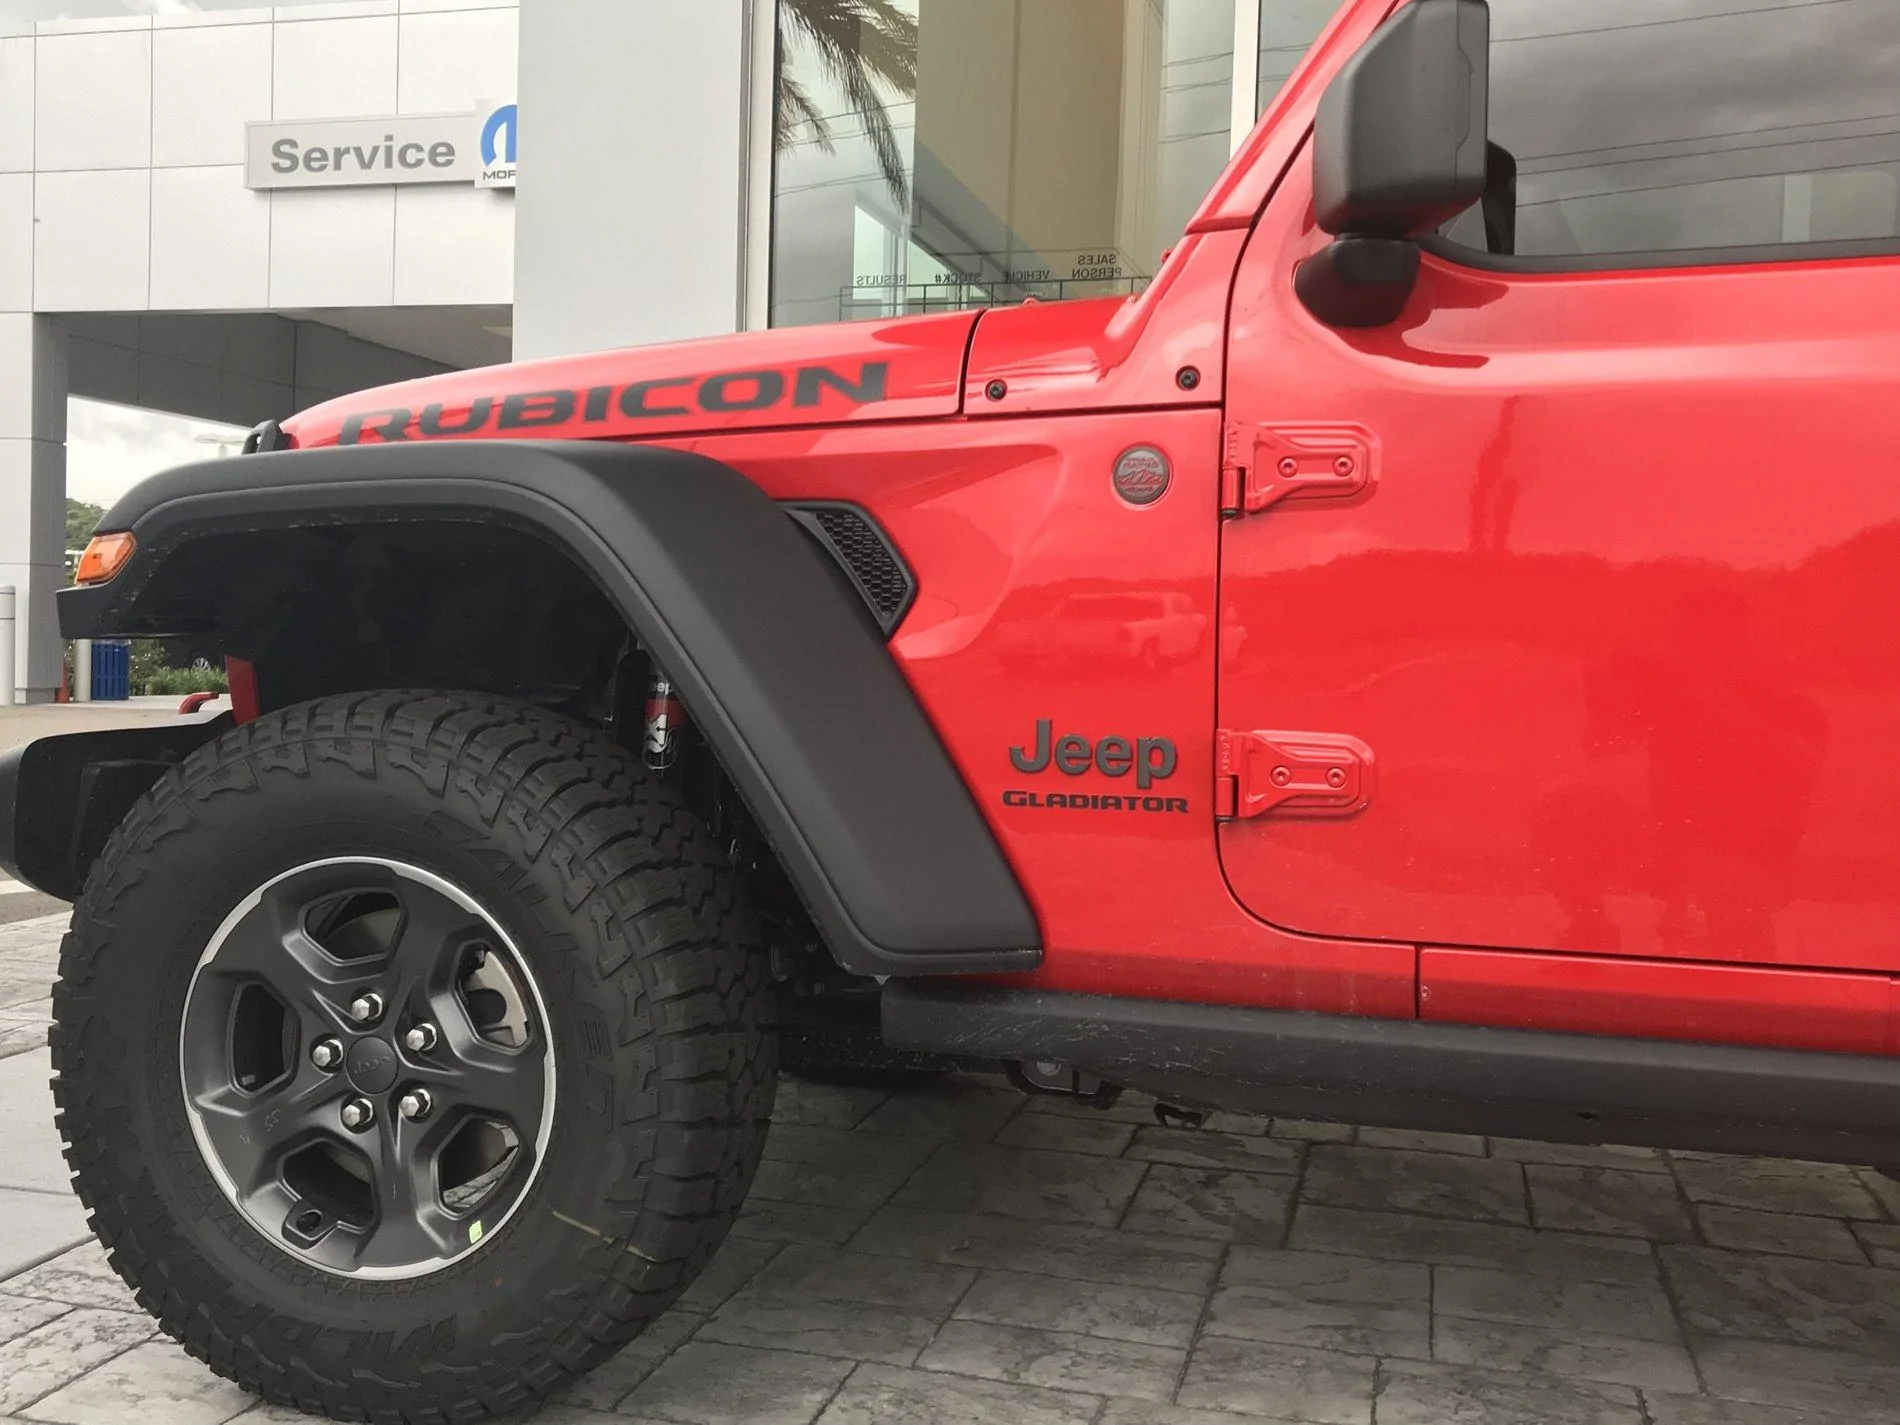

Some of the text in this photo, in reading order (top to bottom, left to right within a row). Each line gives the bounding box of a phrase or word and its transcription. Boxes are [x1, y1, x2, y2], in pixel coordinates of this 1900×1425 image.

[270, 134, 456, 175] Service
[337, 362, 888, 445] RUBICON
[1009, 718, 1178, 789] Jeep
[1002, 790, 1189, 813] GLADIATOR
